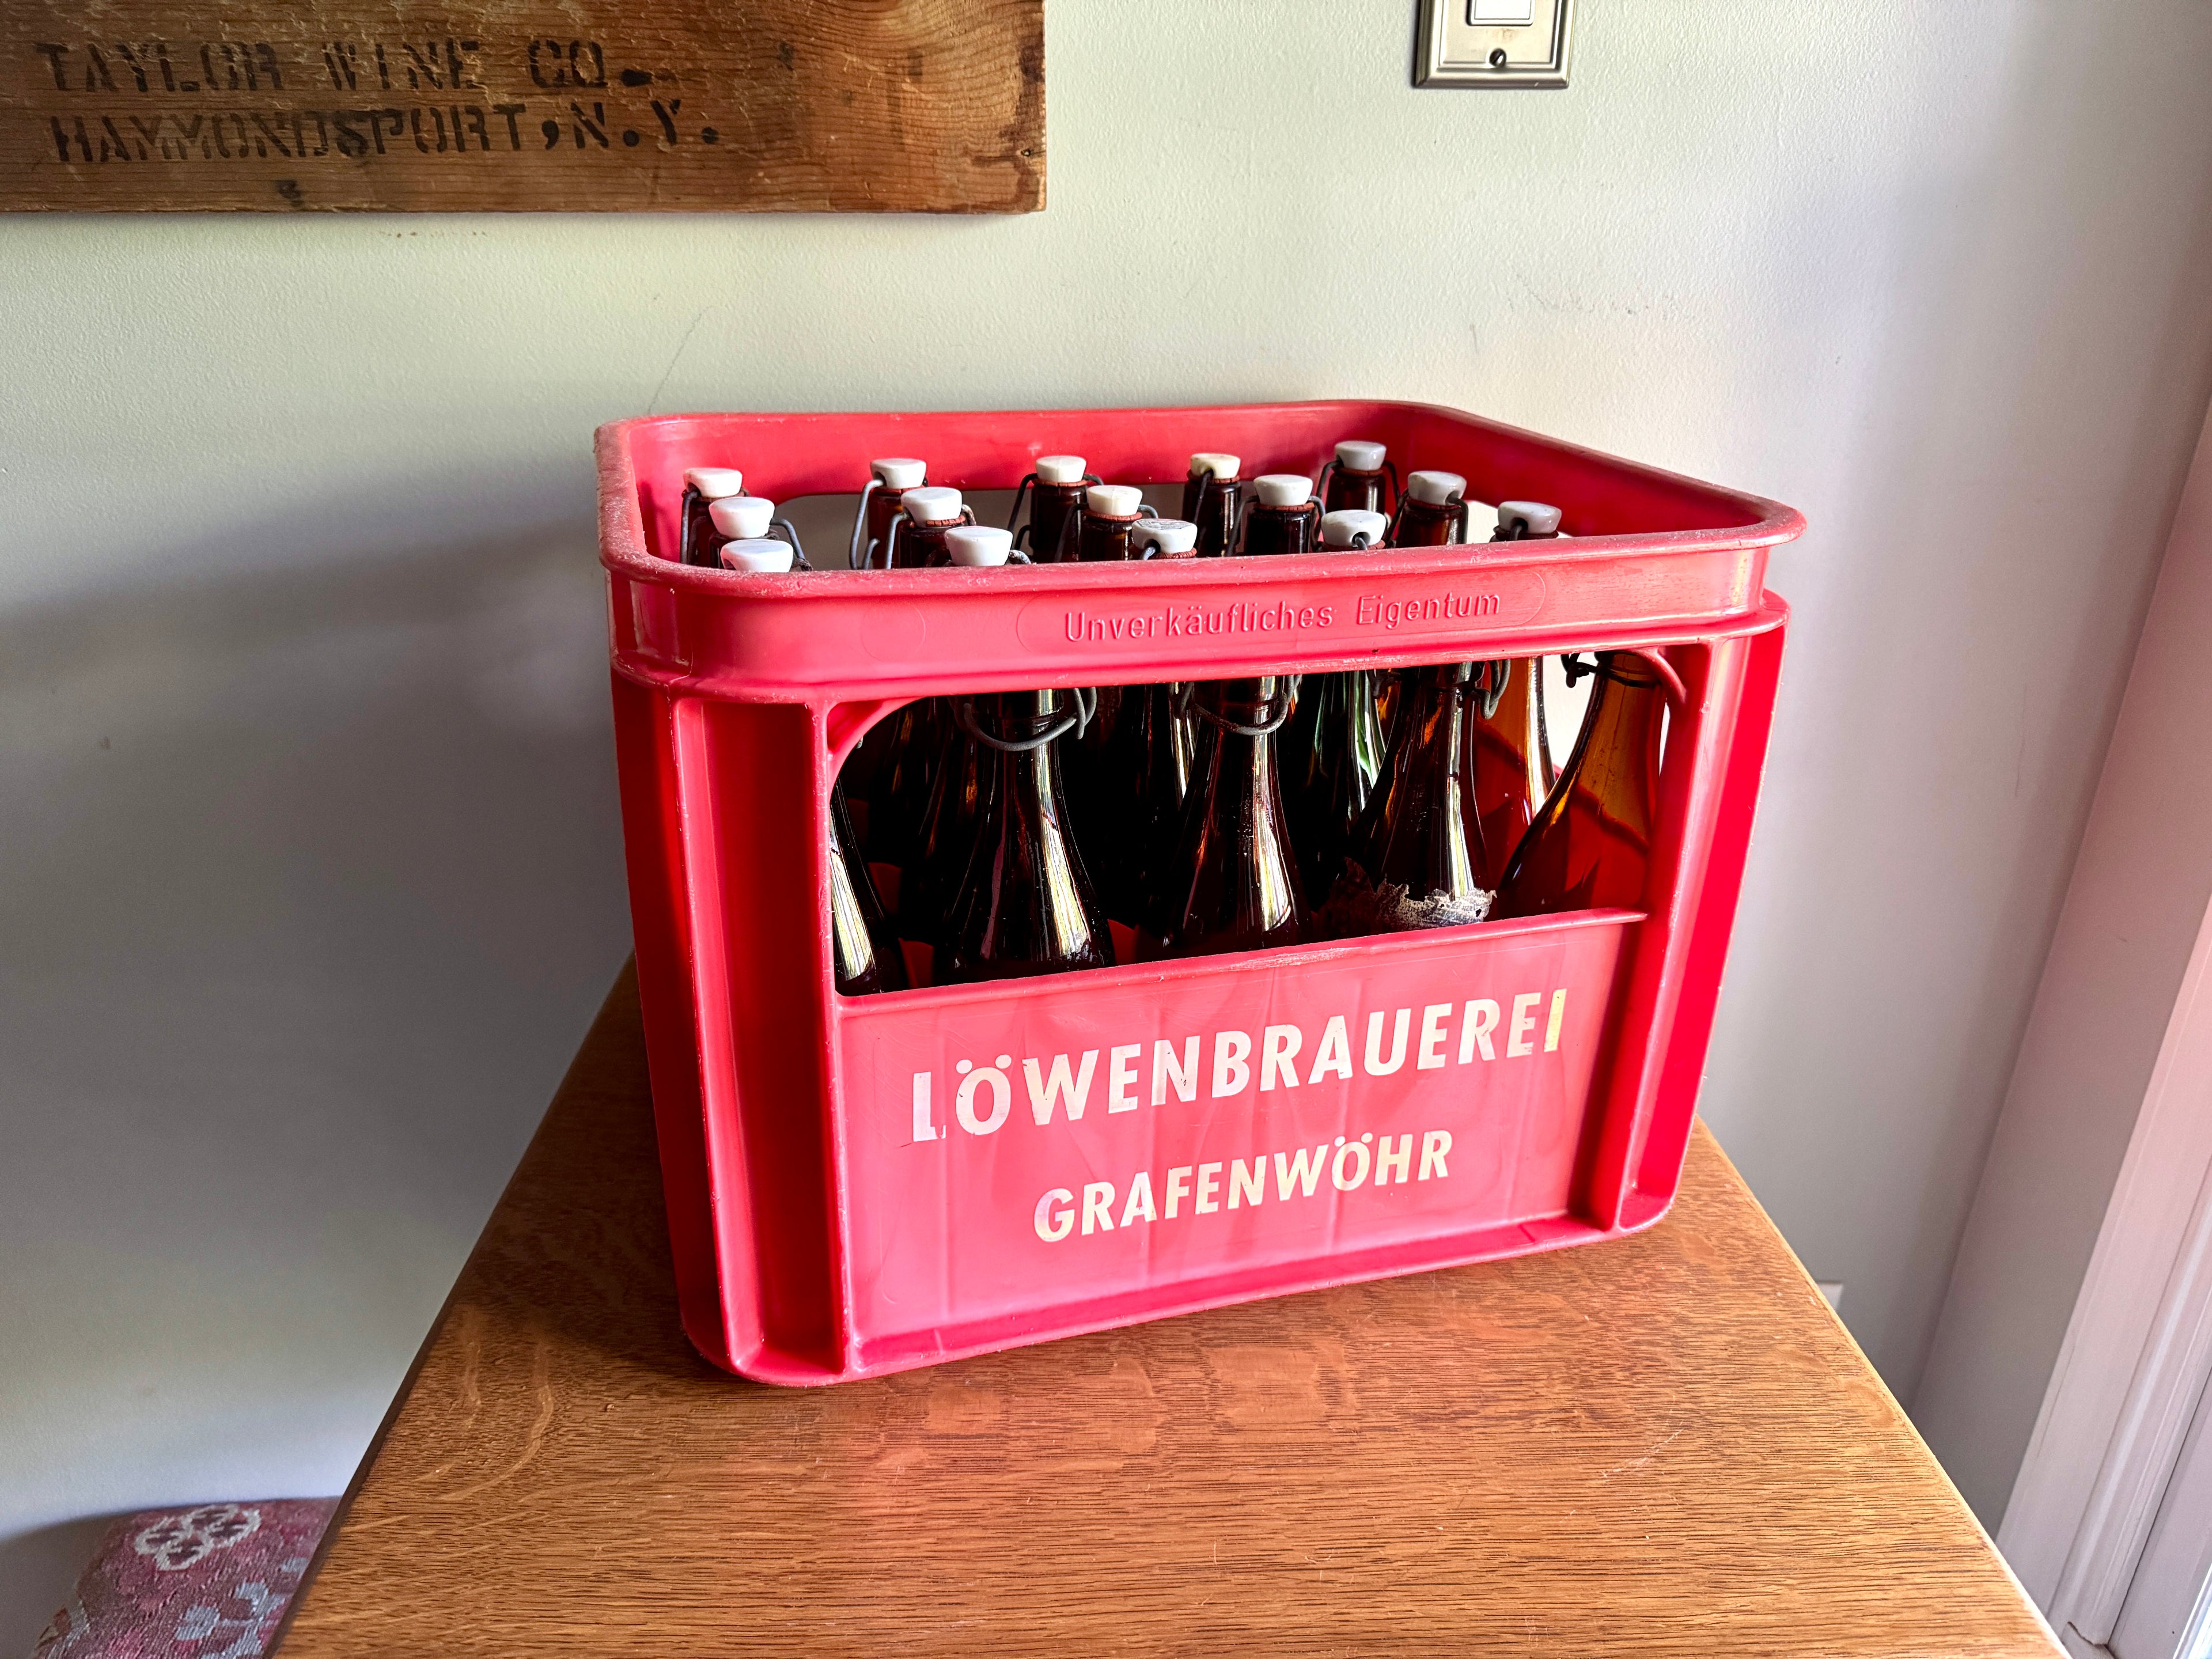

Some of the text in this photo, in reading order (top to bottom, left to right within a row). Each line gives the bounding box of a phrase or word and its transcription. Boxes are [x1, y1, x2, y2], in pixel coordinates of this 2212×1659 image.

[35, 41, 285, 92] TAYLOR
[323, 38, 479, 91] WINE
[1065, 592, 1501, 643] Unverkäufliches Eigentum
[913, 988, 1567, 1143] LÖWENBRAUEREI
[1034, 1129, 1453, 1243] GRAFENWÖHR
